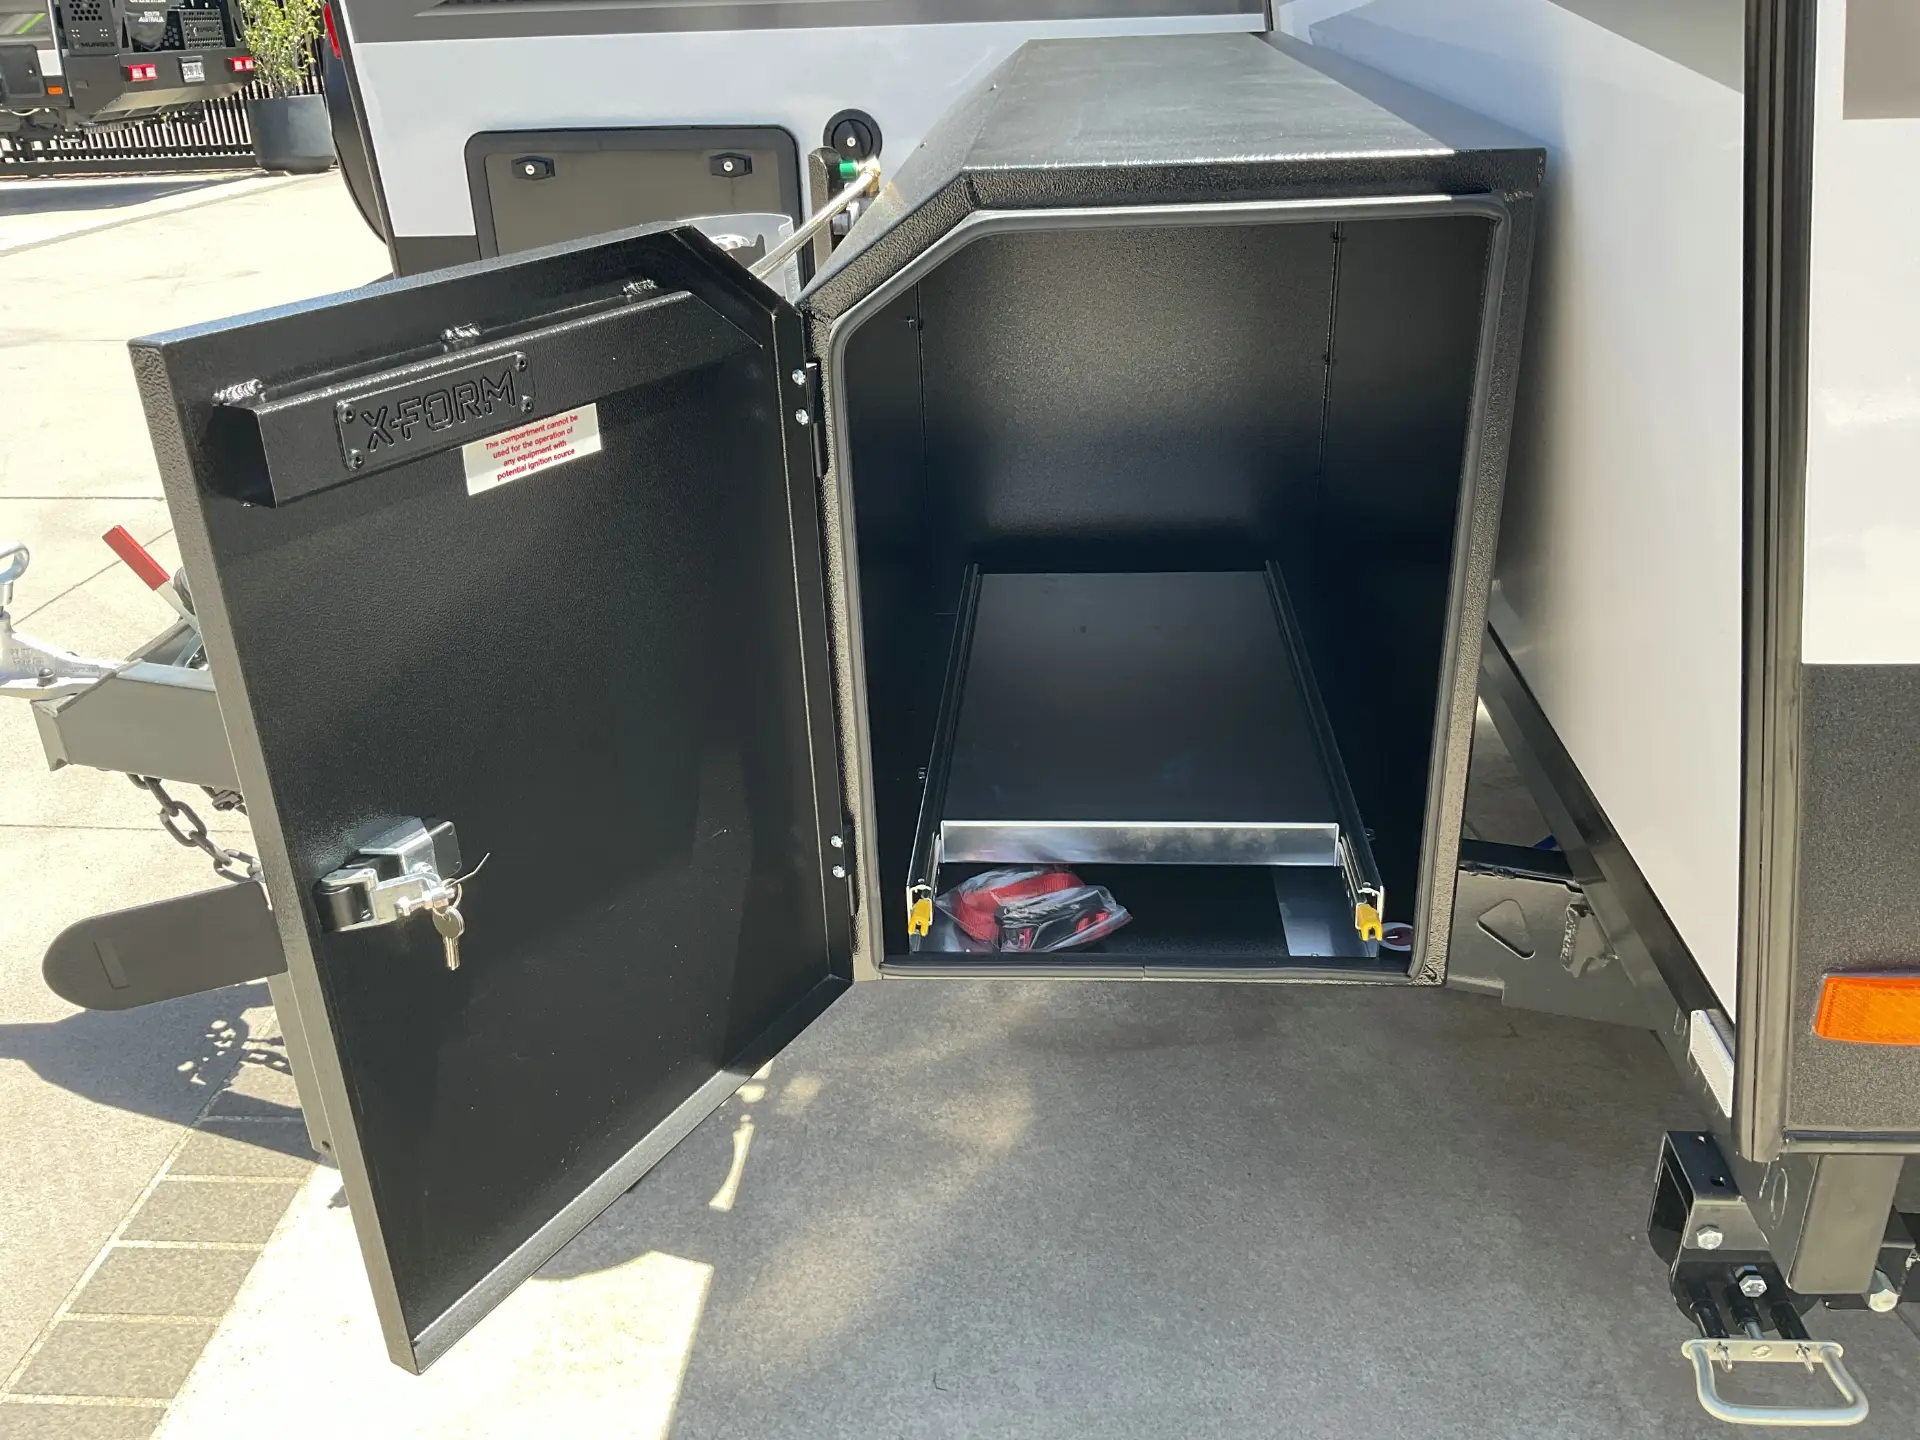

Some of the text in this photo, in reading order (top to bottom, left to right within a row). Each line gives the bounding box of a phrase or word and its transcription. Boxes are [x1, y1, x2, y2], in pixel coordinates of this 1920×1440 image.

[361, 370, 516, 452] X-FORM
[486, 441, 499, 450] This
[501, 425, 545, 445] compartment
[547, 418, 568, 430] cannot
[493, 447, 509, 458] used
[511, 445, 520, 453] for
[523, 441, 533, 450] the
[535, 431, 565, 447] operation
[497, 449, 575, 481] potential ignition source
[504, 440, 566, 466] any equipment with
